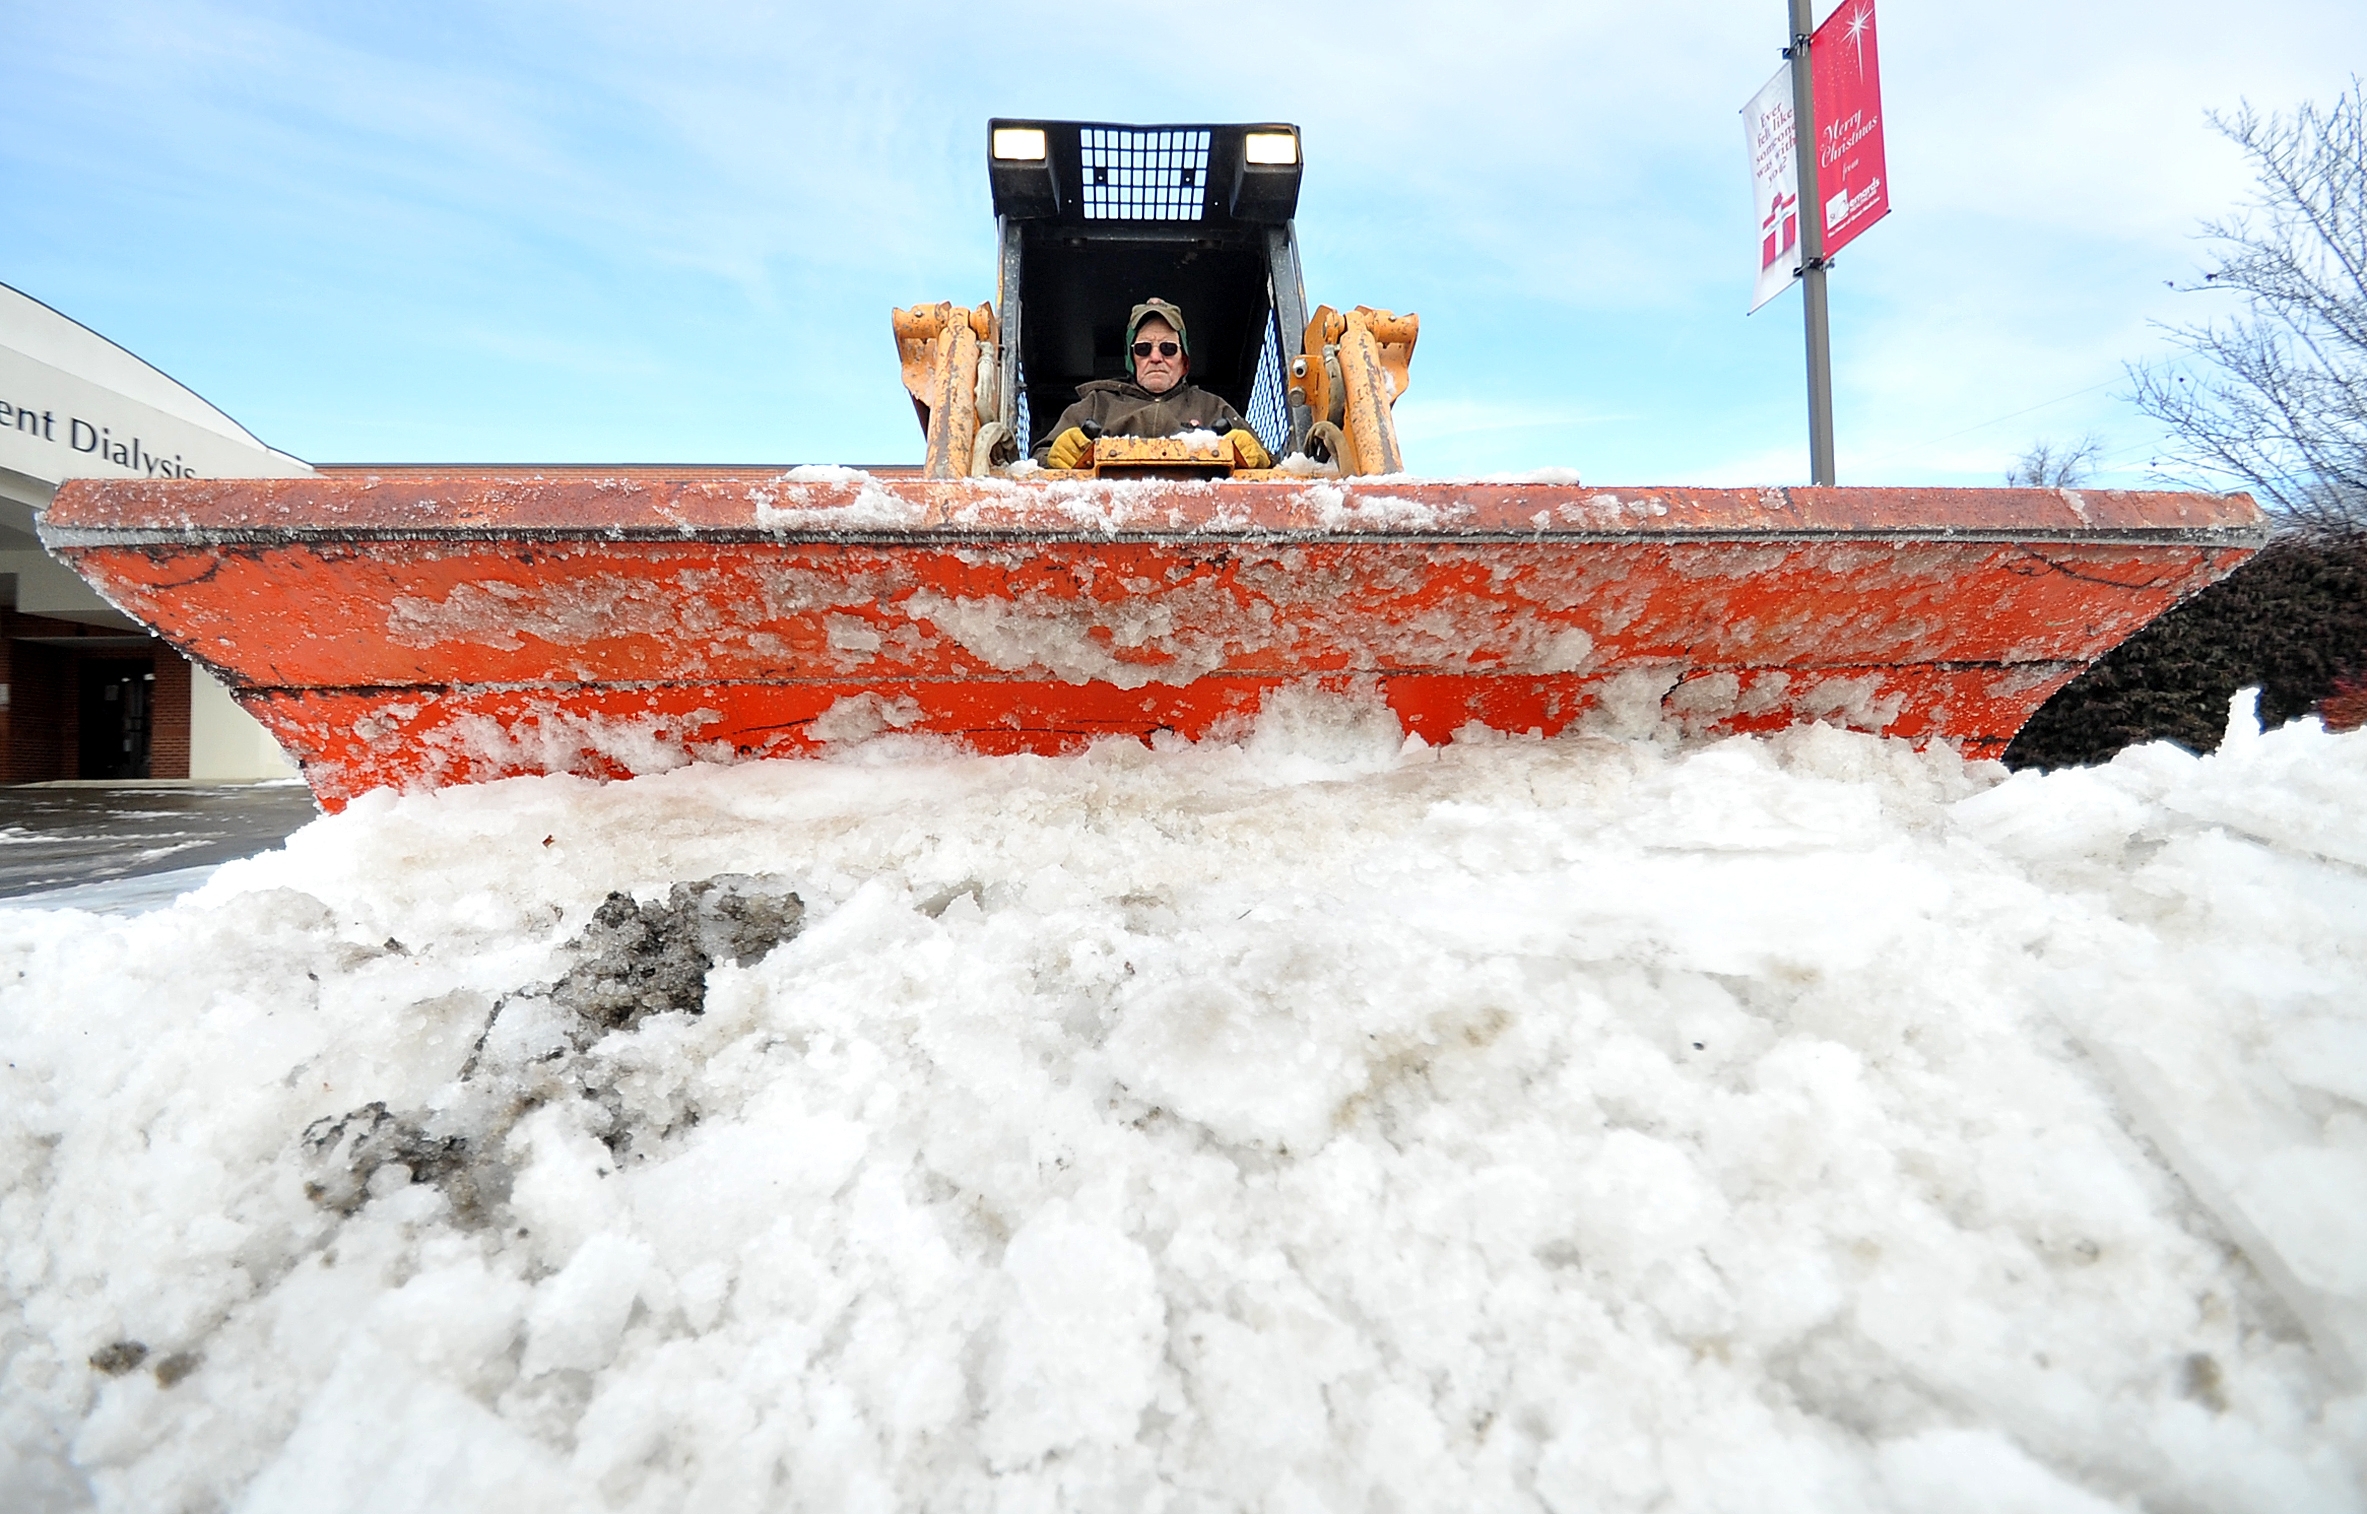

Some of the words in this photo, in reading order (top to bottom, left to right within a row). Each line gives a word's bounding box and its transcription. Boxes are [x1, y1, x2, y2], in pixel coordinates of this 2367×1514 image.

[1757, 128, 1771, 148] felt
[1773, 108, 1793, 131] like
[1760, 102, 1782, 129] Ever
[1821, 109, 1862, 148] Merry
[1756, 159, 1772, 179] was
[1775, 135, 1798, 161] with
[1821, 115, 1878, 169] Christmas
[1768, 156, 1787, 188] you?
[1842, 158, 1859, 182] from
[0, 399, 57, 442] ent
[70, 416, 197, 479] Dialysis
